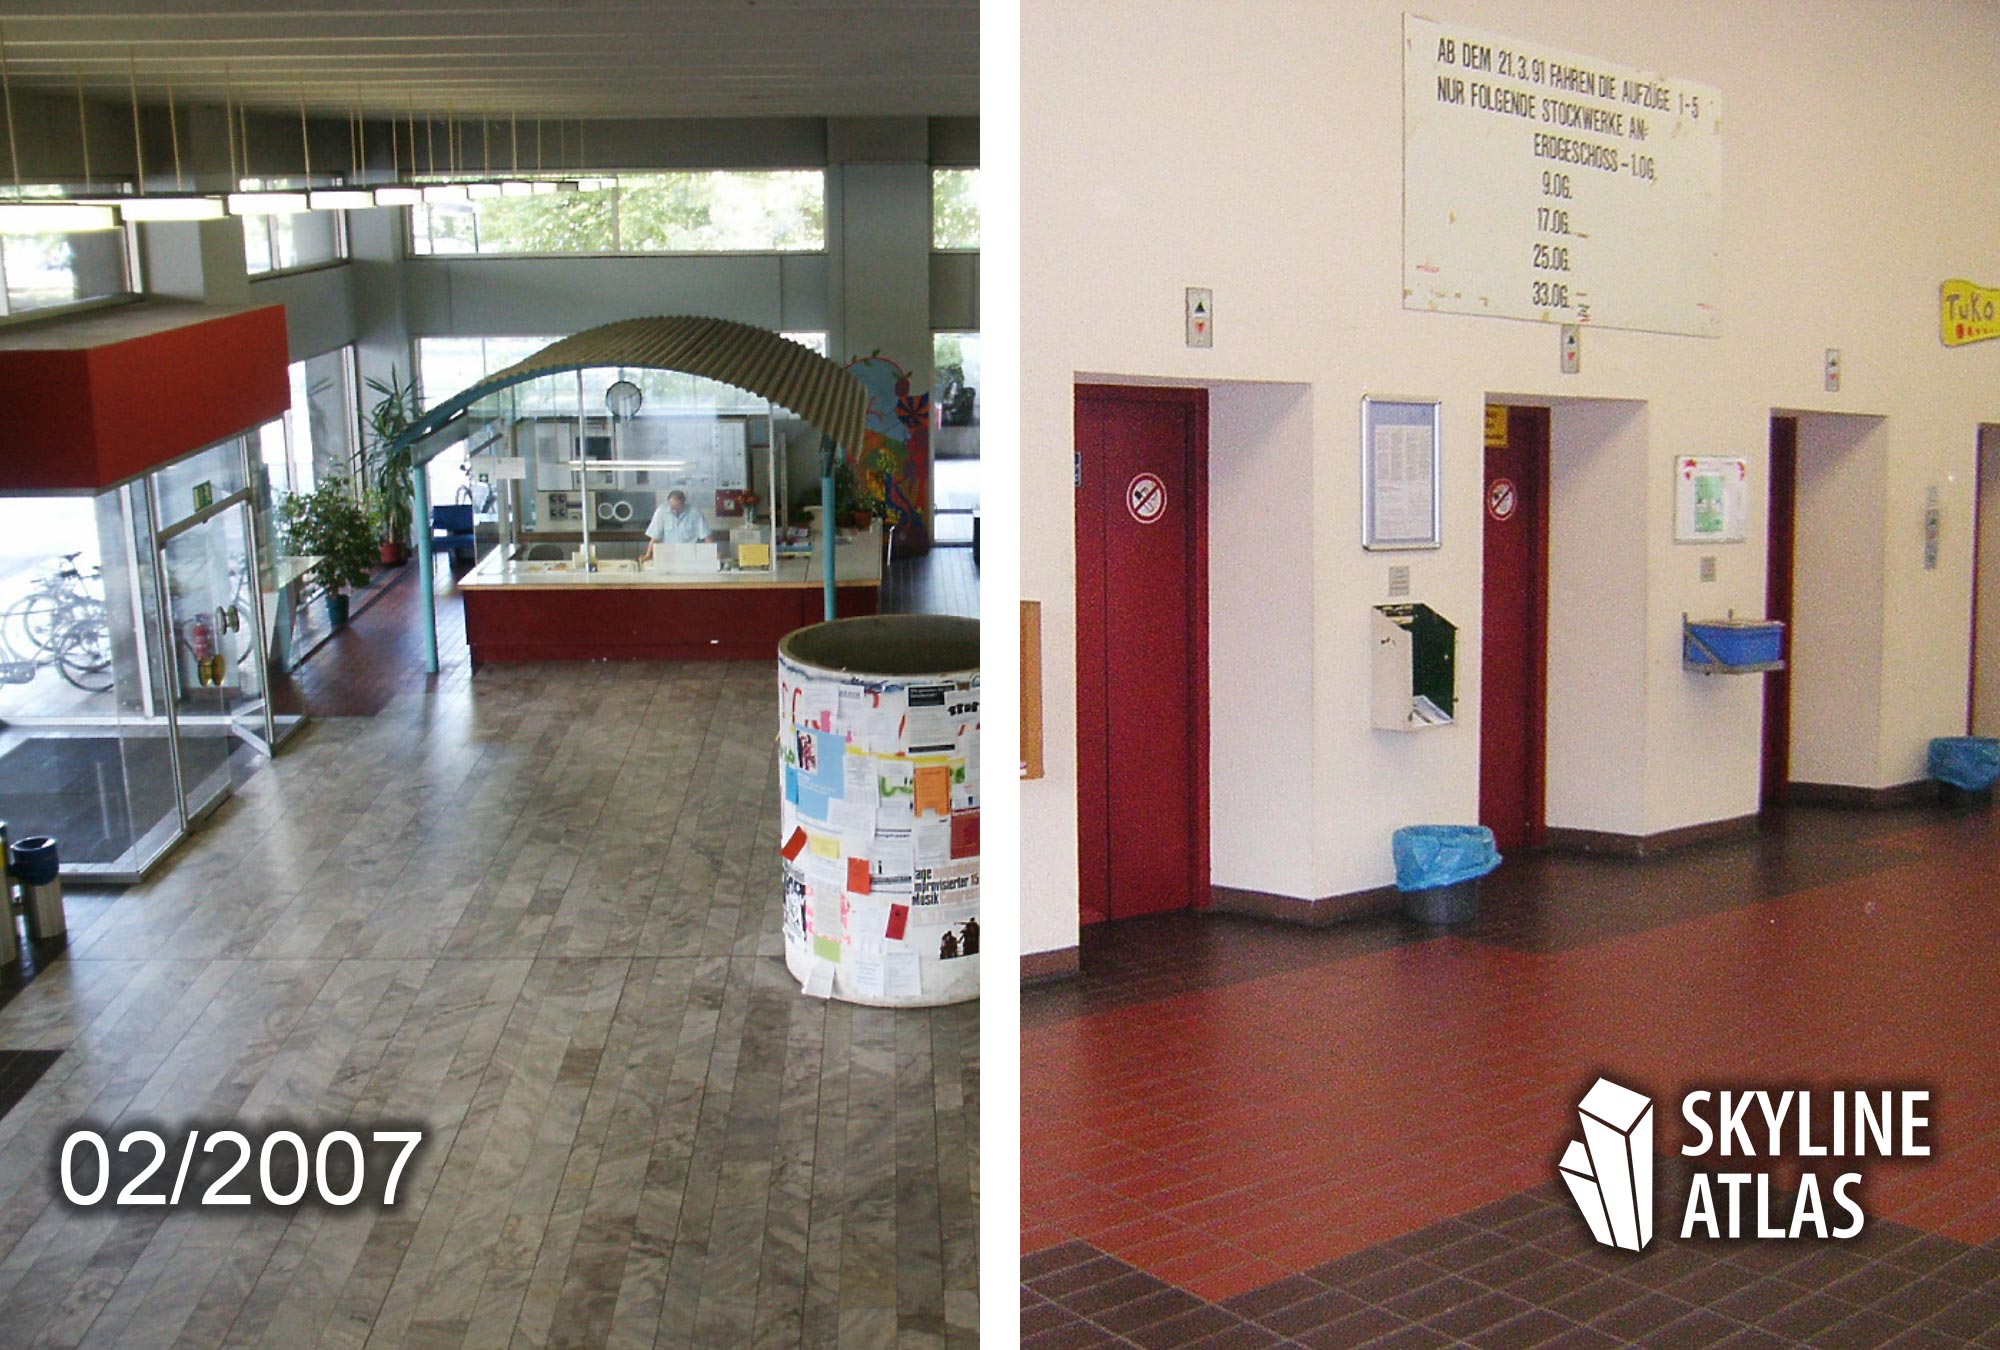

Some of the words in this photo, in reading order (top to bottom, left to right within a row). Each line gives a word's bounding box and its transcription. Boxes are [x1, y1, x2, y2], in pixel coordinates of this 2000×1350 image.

[1437, 38, 1455, 65] AB
[1462, 41, 1491, 73] DEM
[1550, 63, 1595, 97] FAHREN
[1598, 74, 1616, 101] DIE
[1622, 80, 1671, 112] AUFZÜGE
[1437, 76, 1465, 105] NUR
[1471, 83, 1536, 119] FOLGENDE
[1542, 98, 1624, 137] STOCKWERKE
[1534, 133, 1618, 172] ERDGESCHOSS
